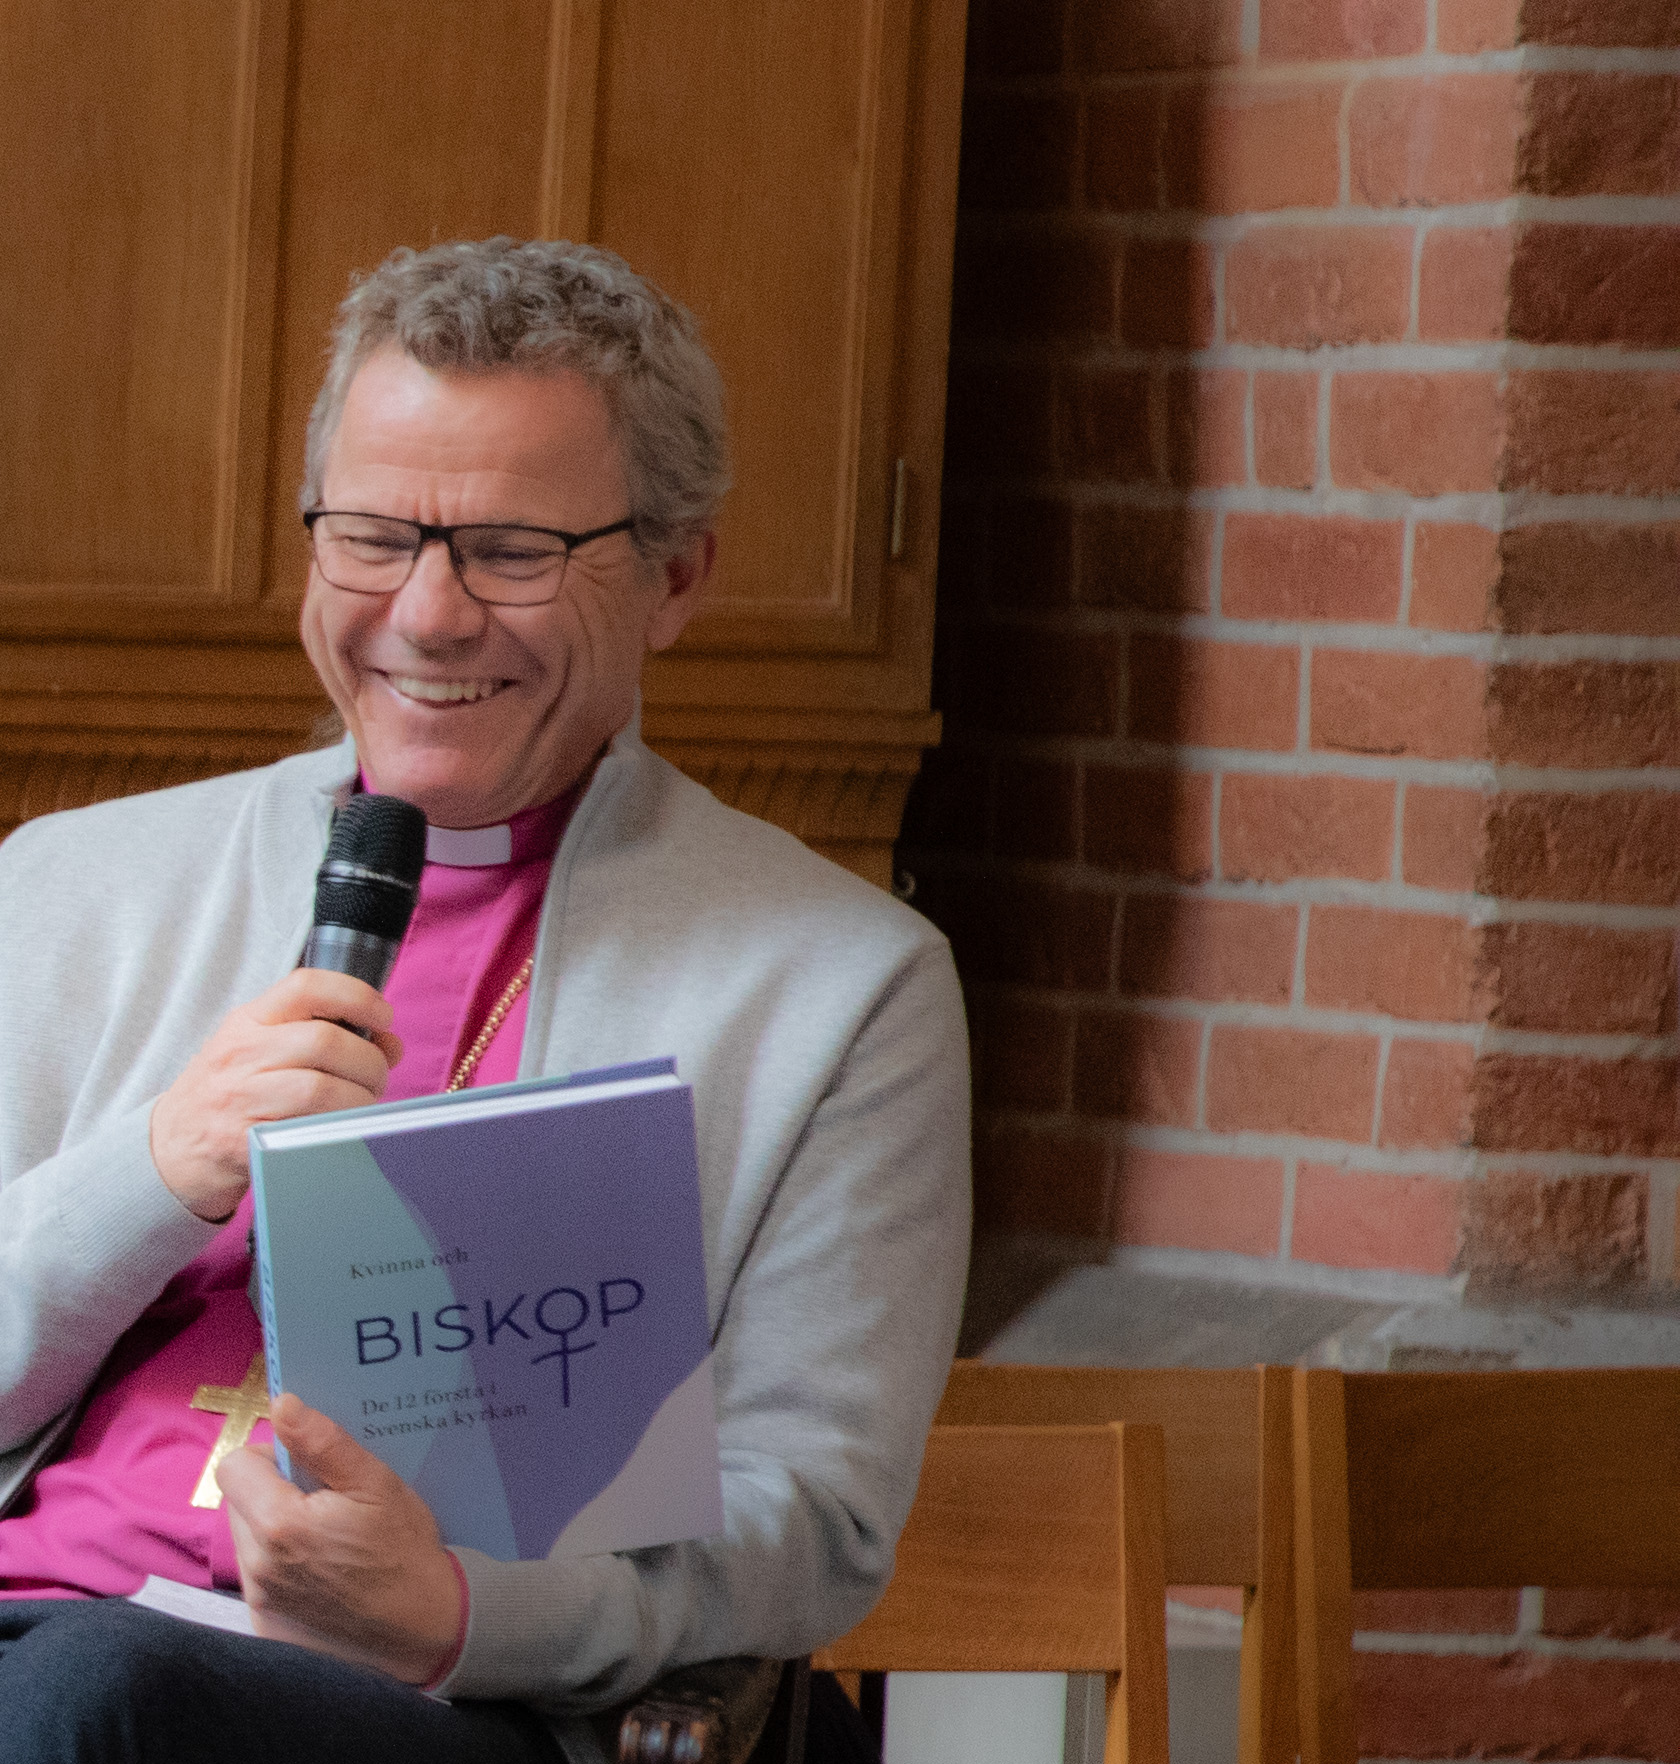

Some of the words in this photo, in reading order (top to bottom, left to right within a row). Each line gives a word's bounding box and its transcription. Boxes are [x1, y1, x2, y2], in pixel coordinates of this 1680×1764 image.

[350, 1258, 425, 1279] Kvinna
[432, 1246, 468, 1266] och
[355, 1277, 645, 1407] BISKOP
[362, 1398, 388, 1416] De
[396, 1393, 416, 1411] 12
[363, 1414, 449, 1440] Svenska
[453, 1403, 527, 1429] kyrkan
